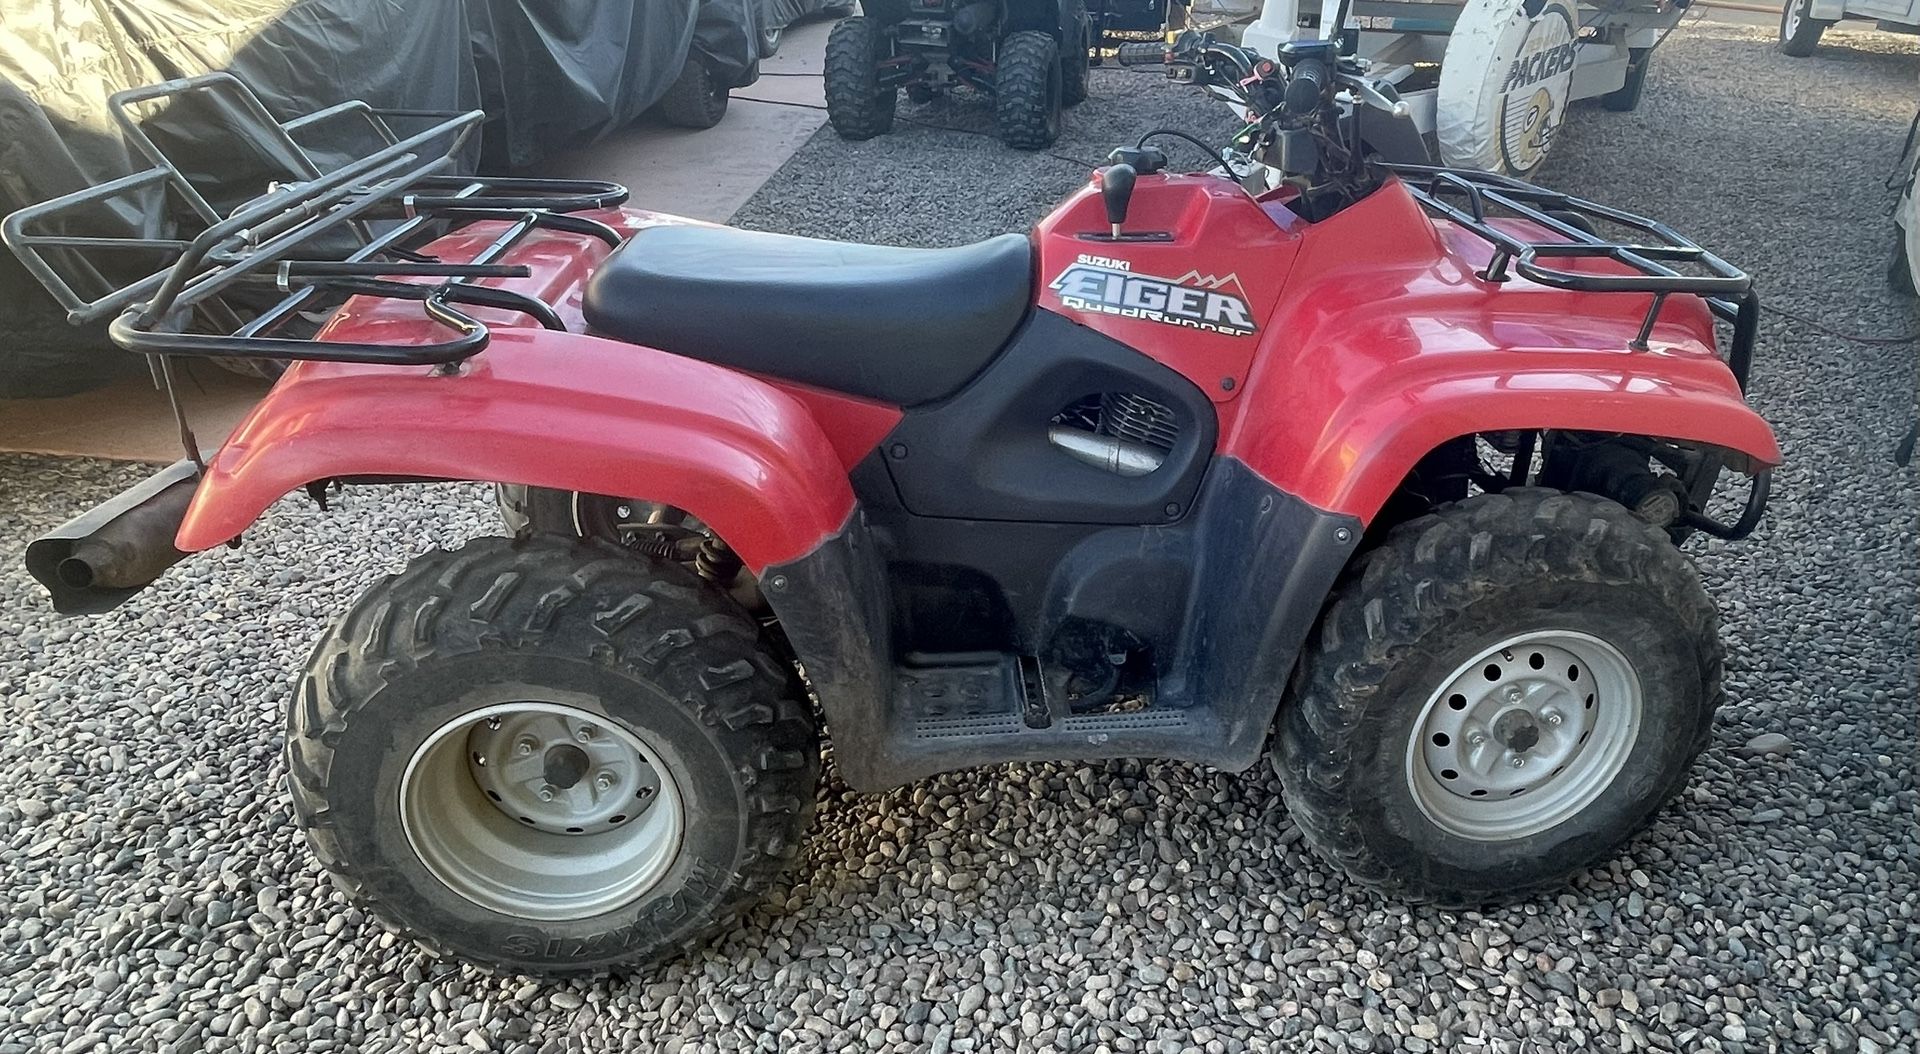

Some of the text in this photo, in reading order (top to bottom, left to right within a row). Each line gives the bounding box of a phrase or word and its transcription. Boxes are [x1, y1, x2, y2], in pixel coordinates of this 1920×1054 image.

[1499, 40, 1578, 94] PACKERS
[1077, 254, 1131, 272] SUZUKI
[1058, 268, 1257, 331] EIGER
[1062, 295, 1254, 337] QuadRunner
[501, 856, 720, 958] MAXIS
